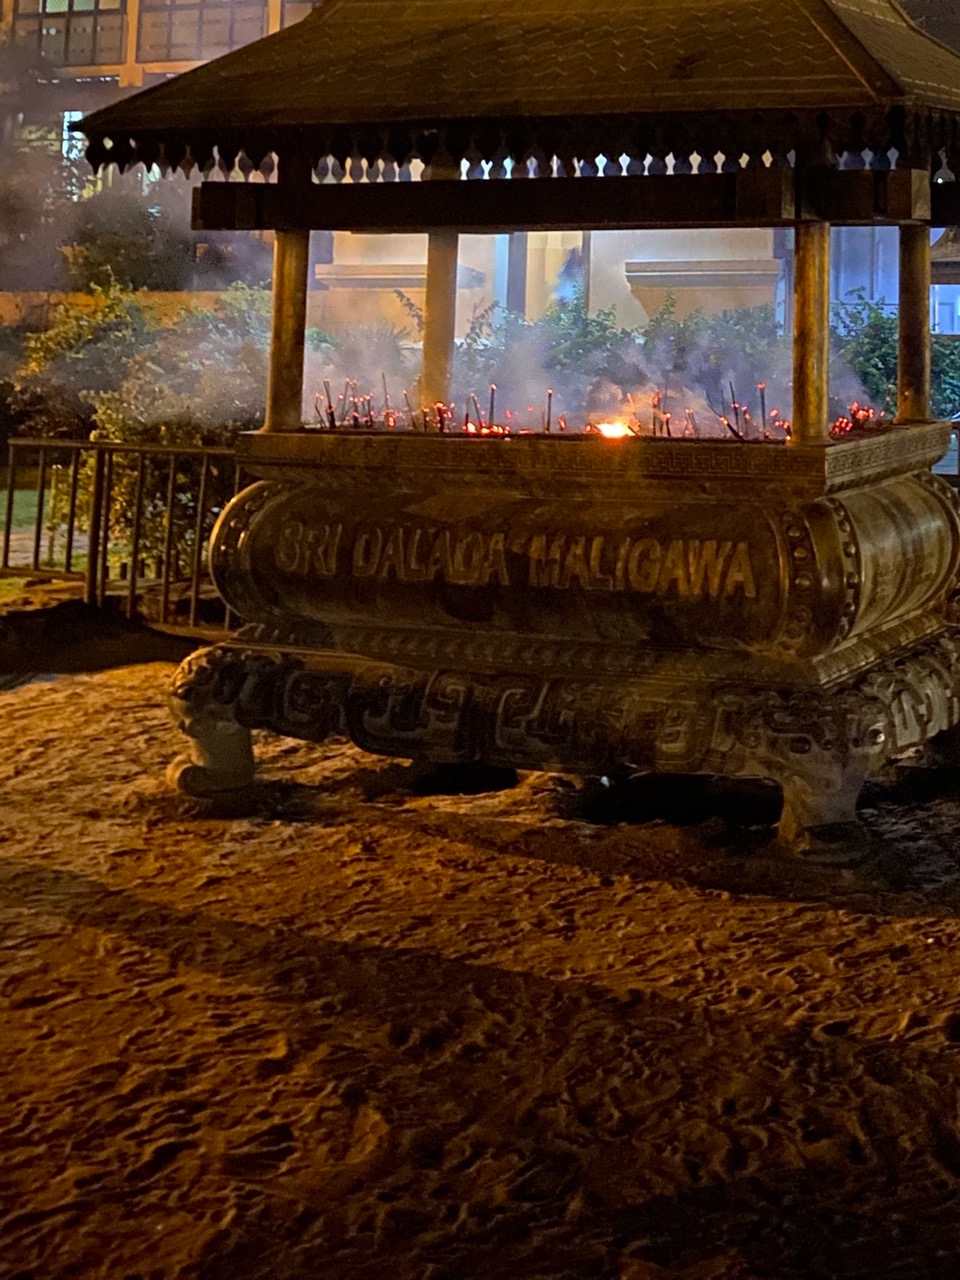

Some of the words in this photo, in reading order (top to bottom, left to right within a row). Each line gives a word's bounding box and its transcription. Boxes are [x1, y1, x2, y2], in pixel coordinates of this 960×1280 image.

[275, 522, 342, 576] SRI
[352, 526, 511, 586] DALADA
[527, 533, 758, 598] MALIGAWA
